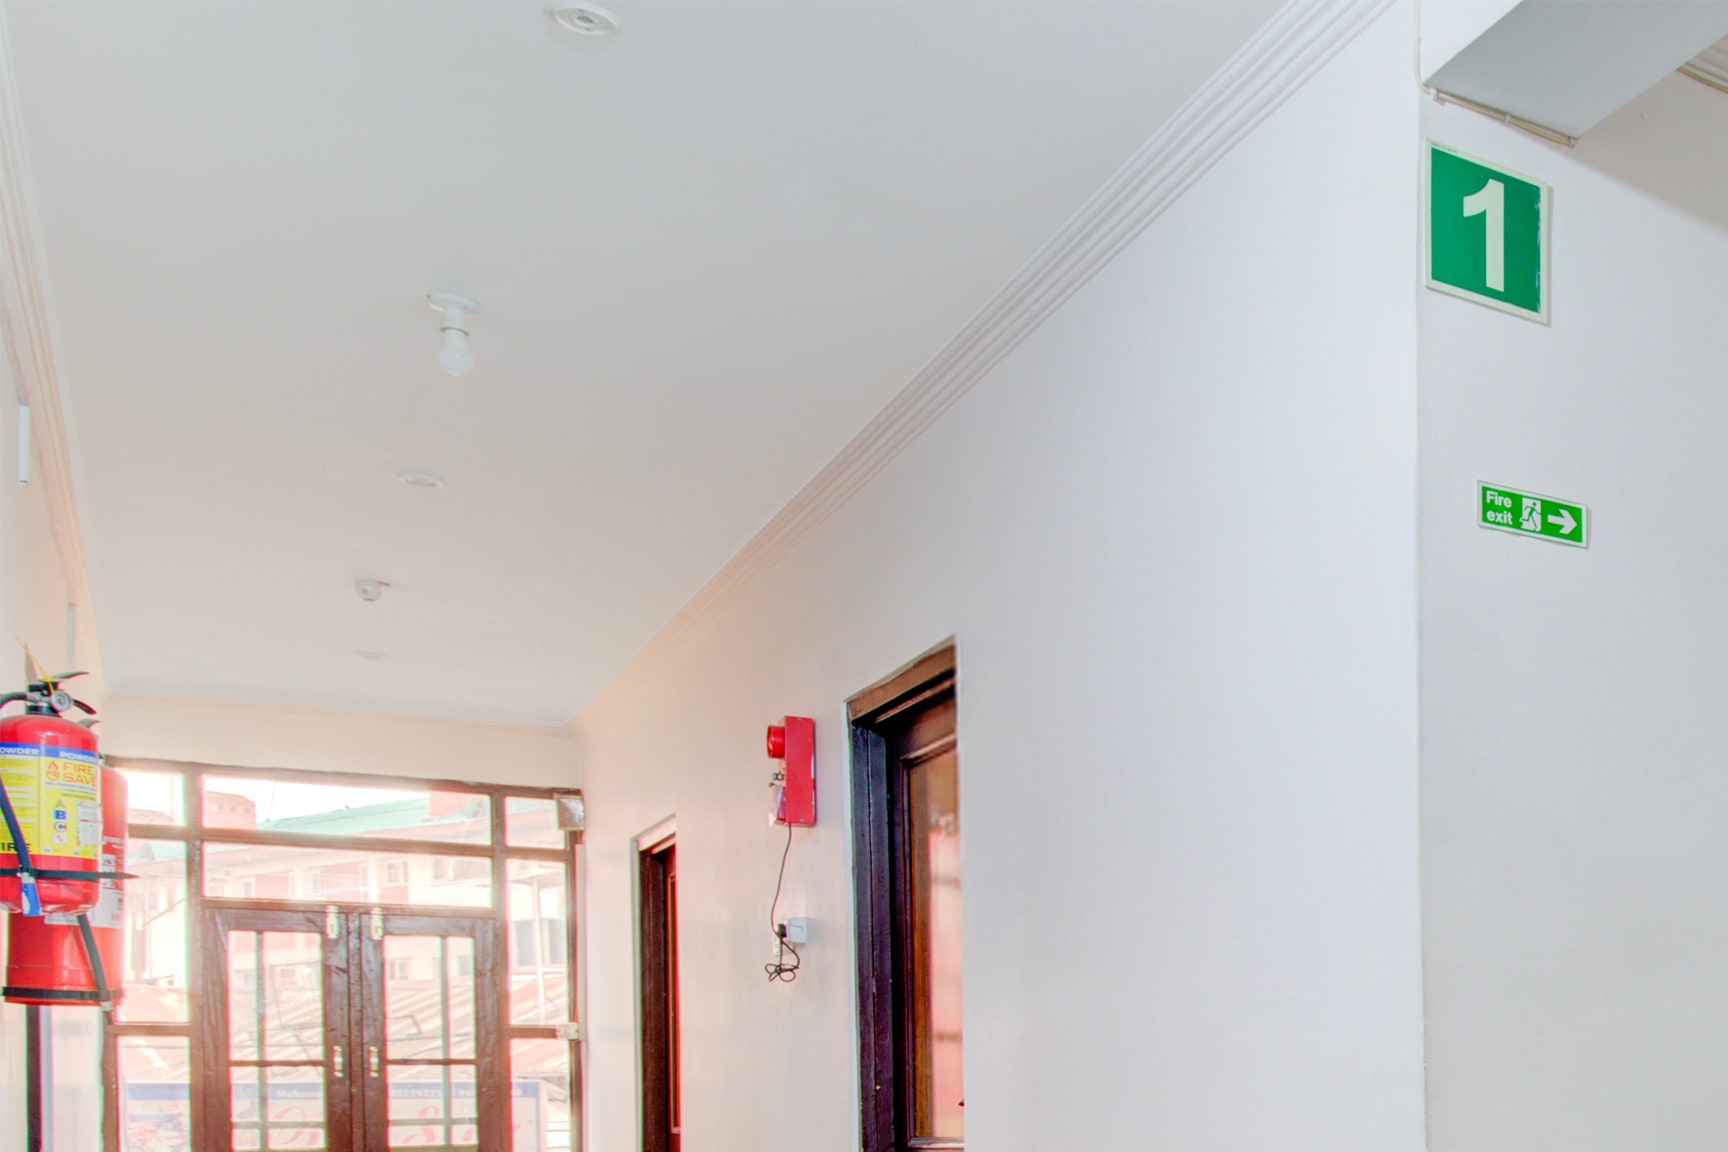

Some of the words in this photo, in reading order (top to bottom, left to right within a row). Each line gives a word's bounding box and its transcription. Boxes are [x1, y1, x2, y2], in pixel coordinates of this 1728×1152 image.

[1463, 178, 1504, 292] 1
[1486, 490, 1512, 508] Fire
[1486, 510, 1513, 525] exit
[0, 747, 39, 756] OWDER
